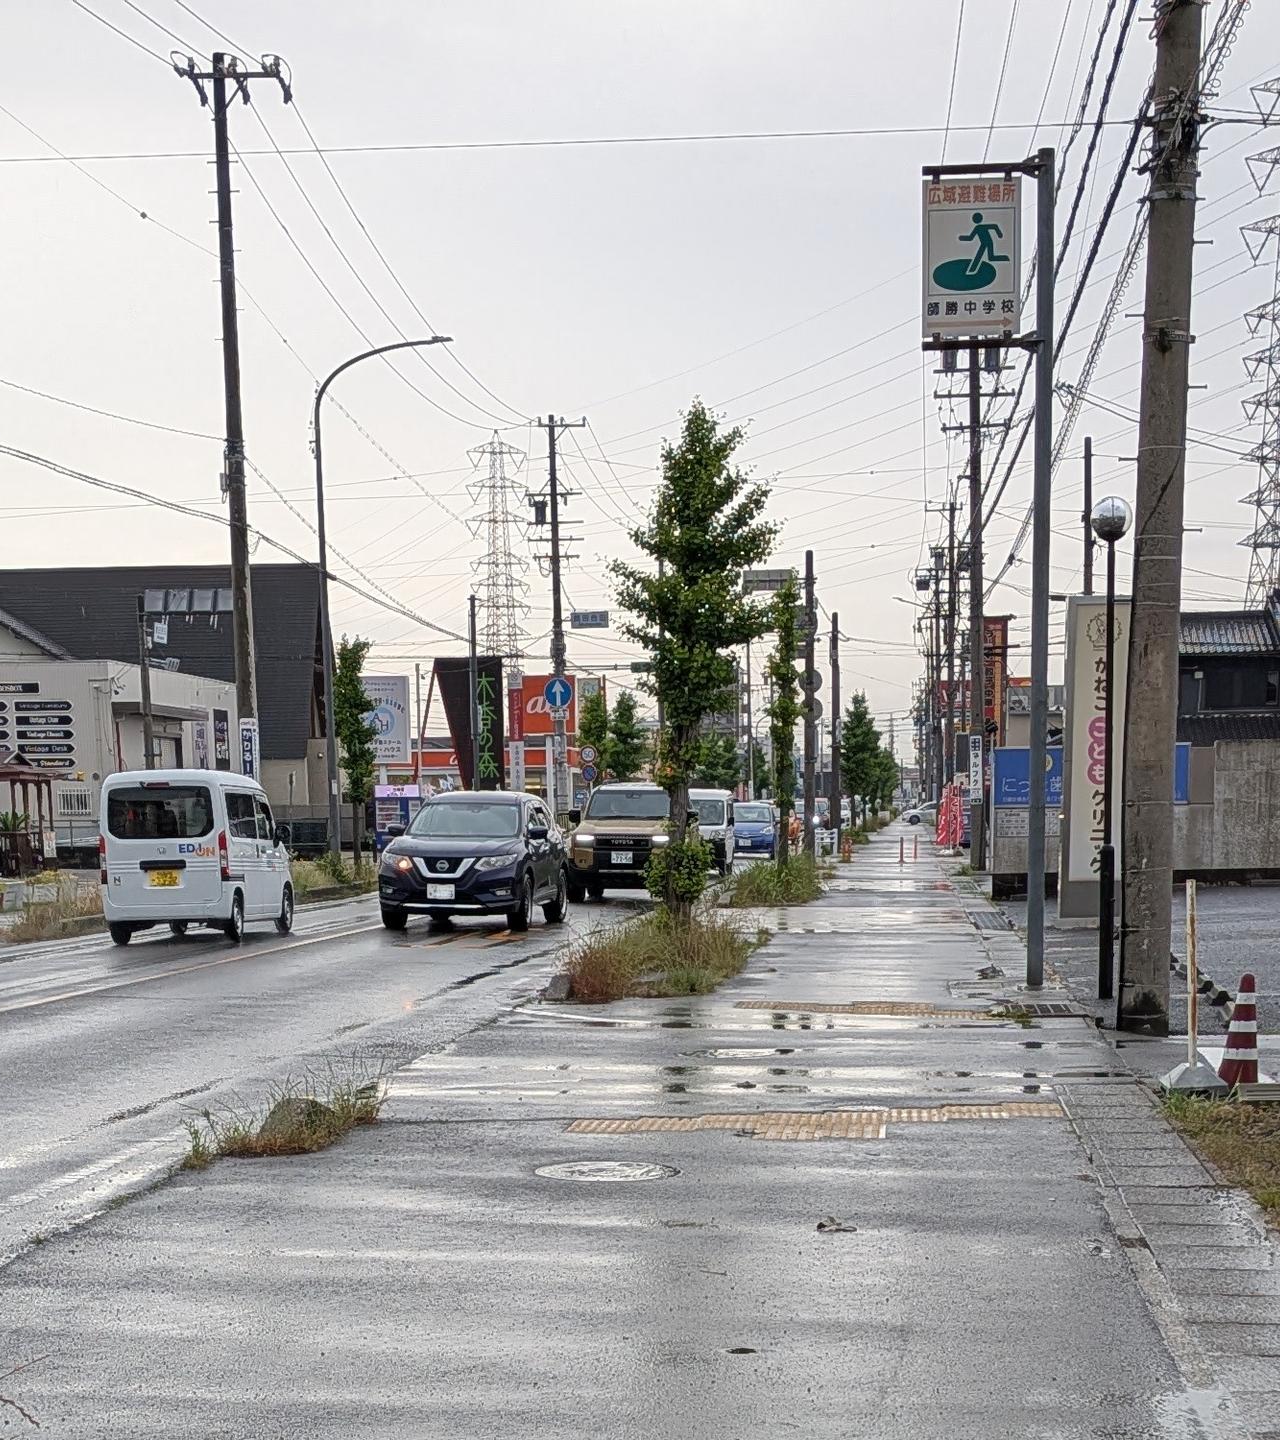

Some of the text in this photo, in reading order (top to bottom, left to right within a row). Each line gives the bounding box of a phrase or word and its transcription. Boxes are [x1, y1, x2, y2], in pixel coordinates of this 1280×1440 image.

[928, 184, 1016, 204] 広域避難場所
[927, 299, 1014, 316] 師勝中学校
[476, 672, 500, 778] 木香の森
[584, 750, 593, 759] 50
[178, 843, 215, 857] EDION
